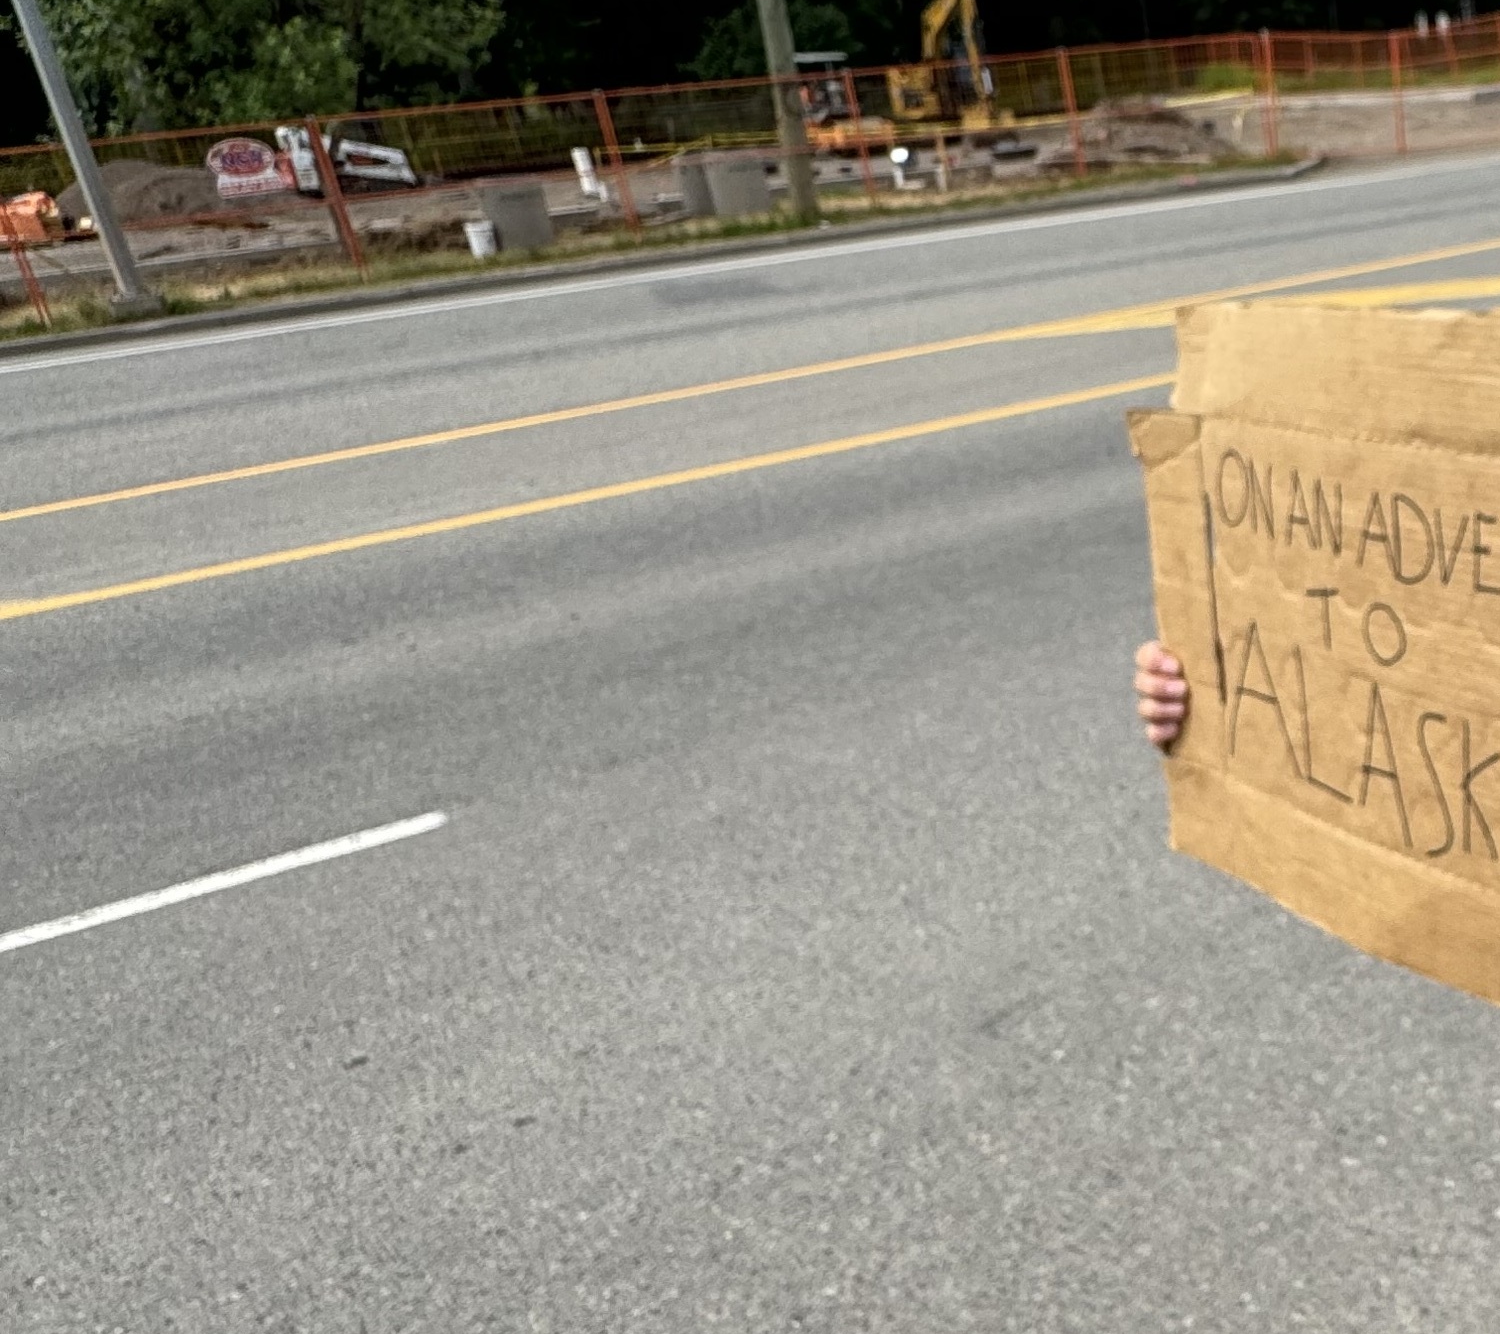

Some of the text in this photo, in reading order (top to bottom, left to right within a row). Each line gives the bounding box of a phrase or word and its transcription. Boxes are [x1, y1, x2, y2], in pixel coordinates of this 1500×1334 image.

[1214, 447, 1276, 540] ON
[1284, 468, 1343, 557] AN
[1305, 586, 1408, 668] TO
